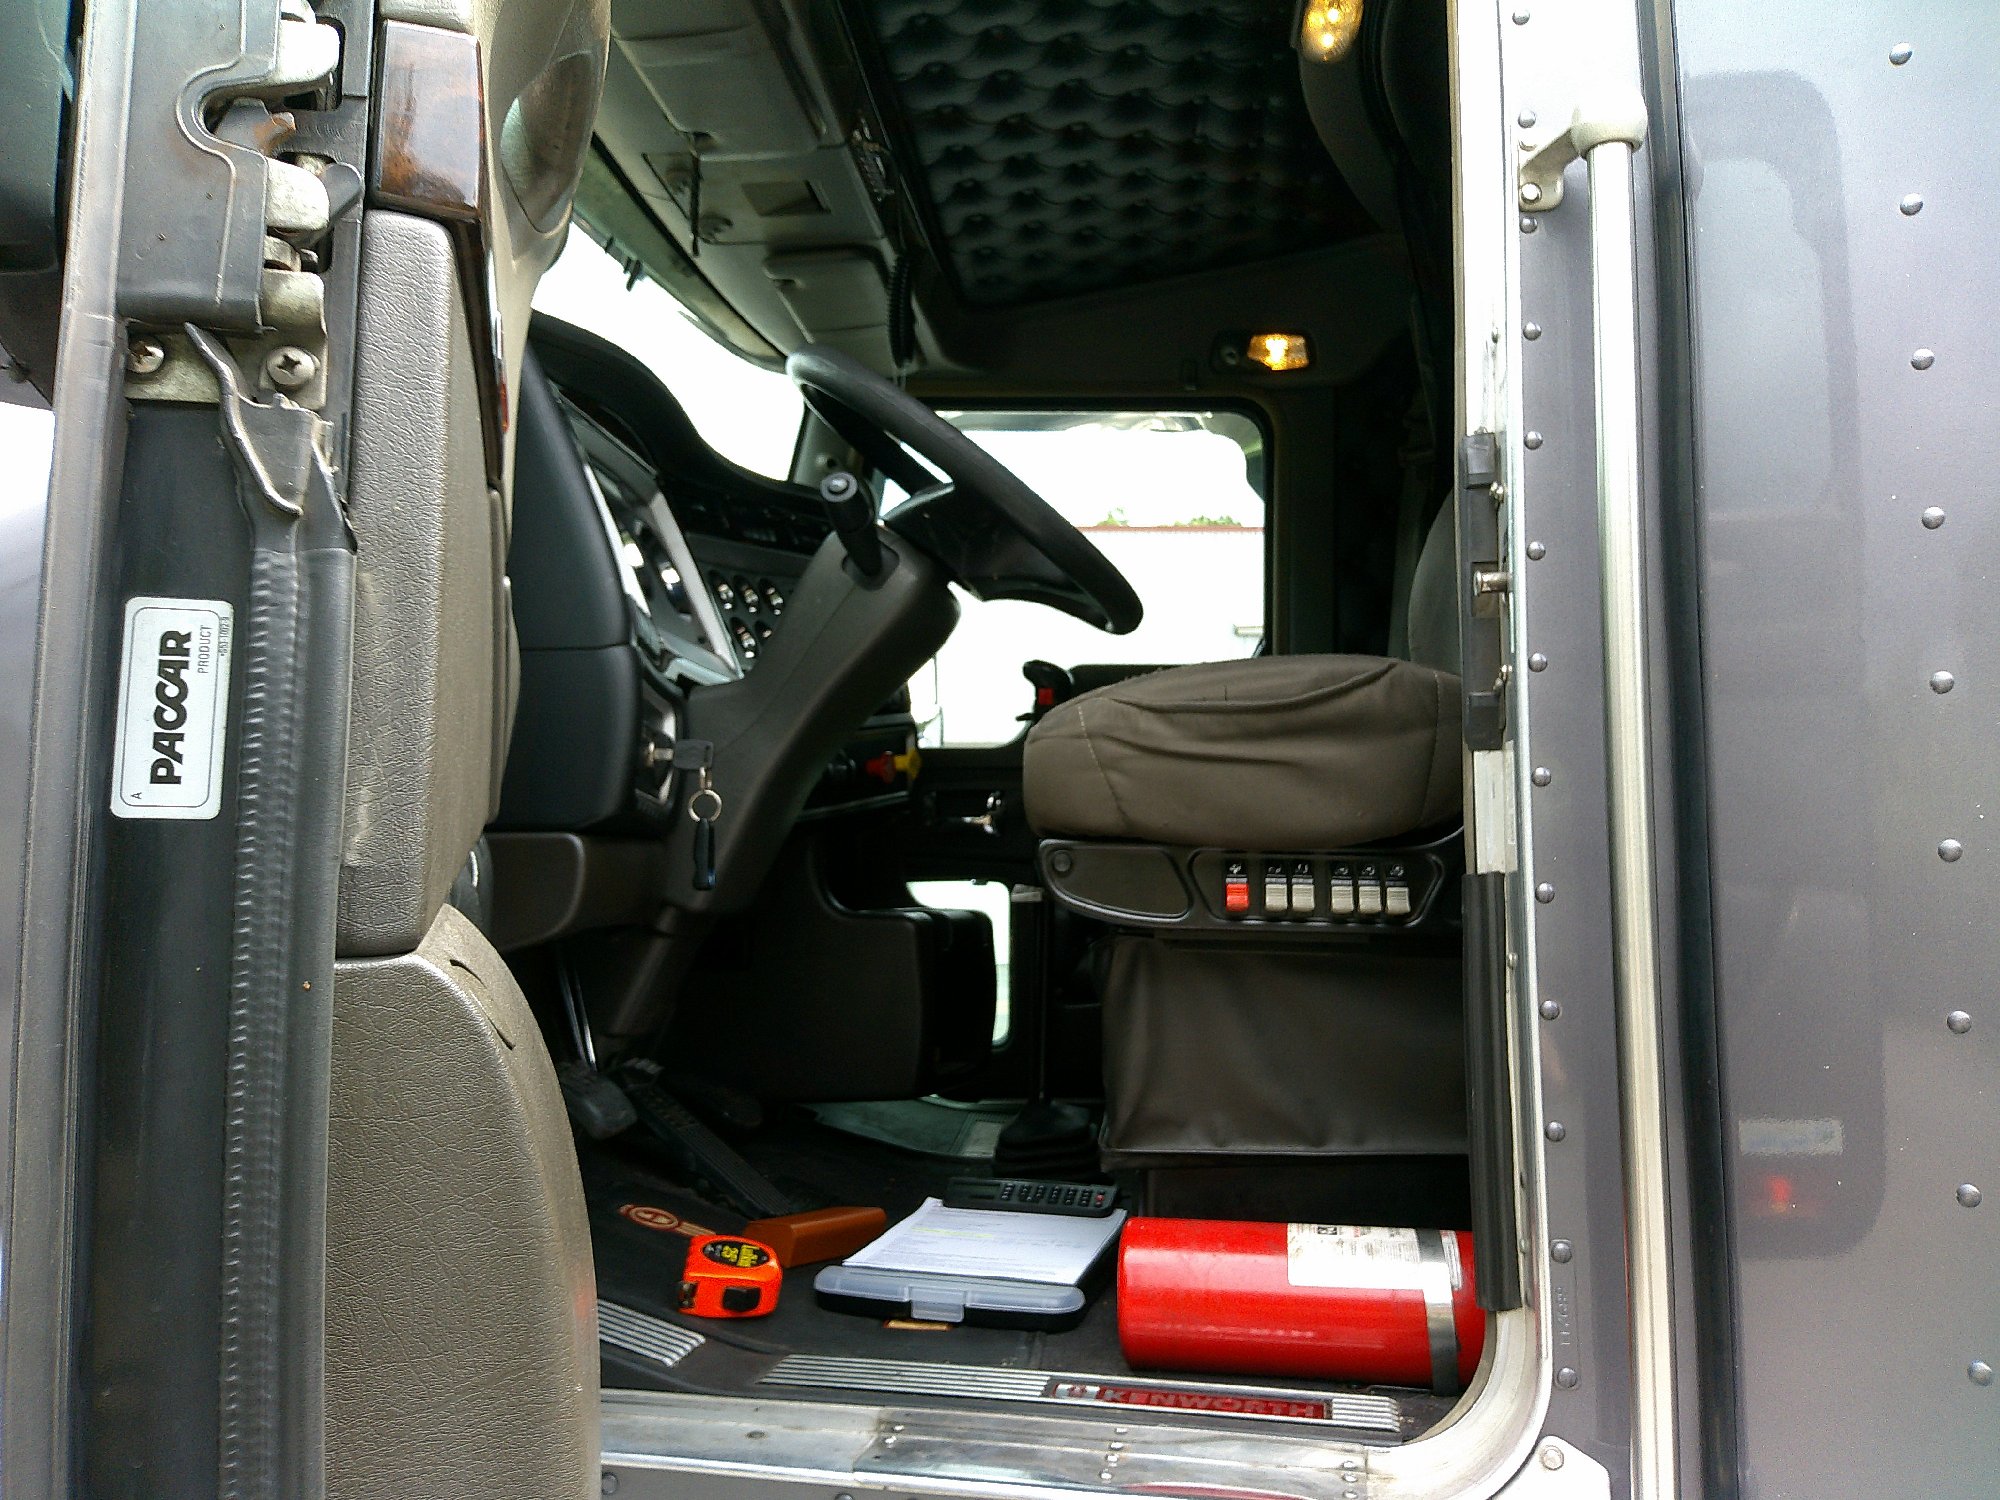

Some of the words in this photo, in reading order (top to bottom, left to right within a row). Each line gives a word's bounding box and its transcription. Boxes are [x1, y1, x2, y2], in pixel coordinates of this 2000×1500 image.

[197, 624, 213, 674] PRODUCT
[150, 630, 192, 785] PACCAR
[130, 791, 143, 800] A
[1103, 1388, 1314, 1418] KENWORTH
